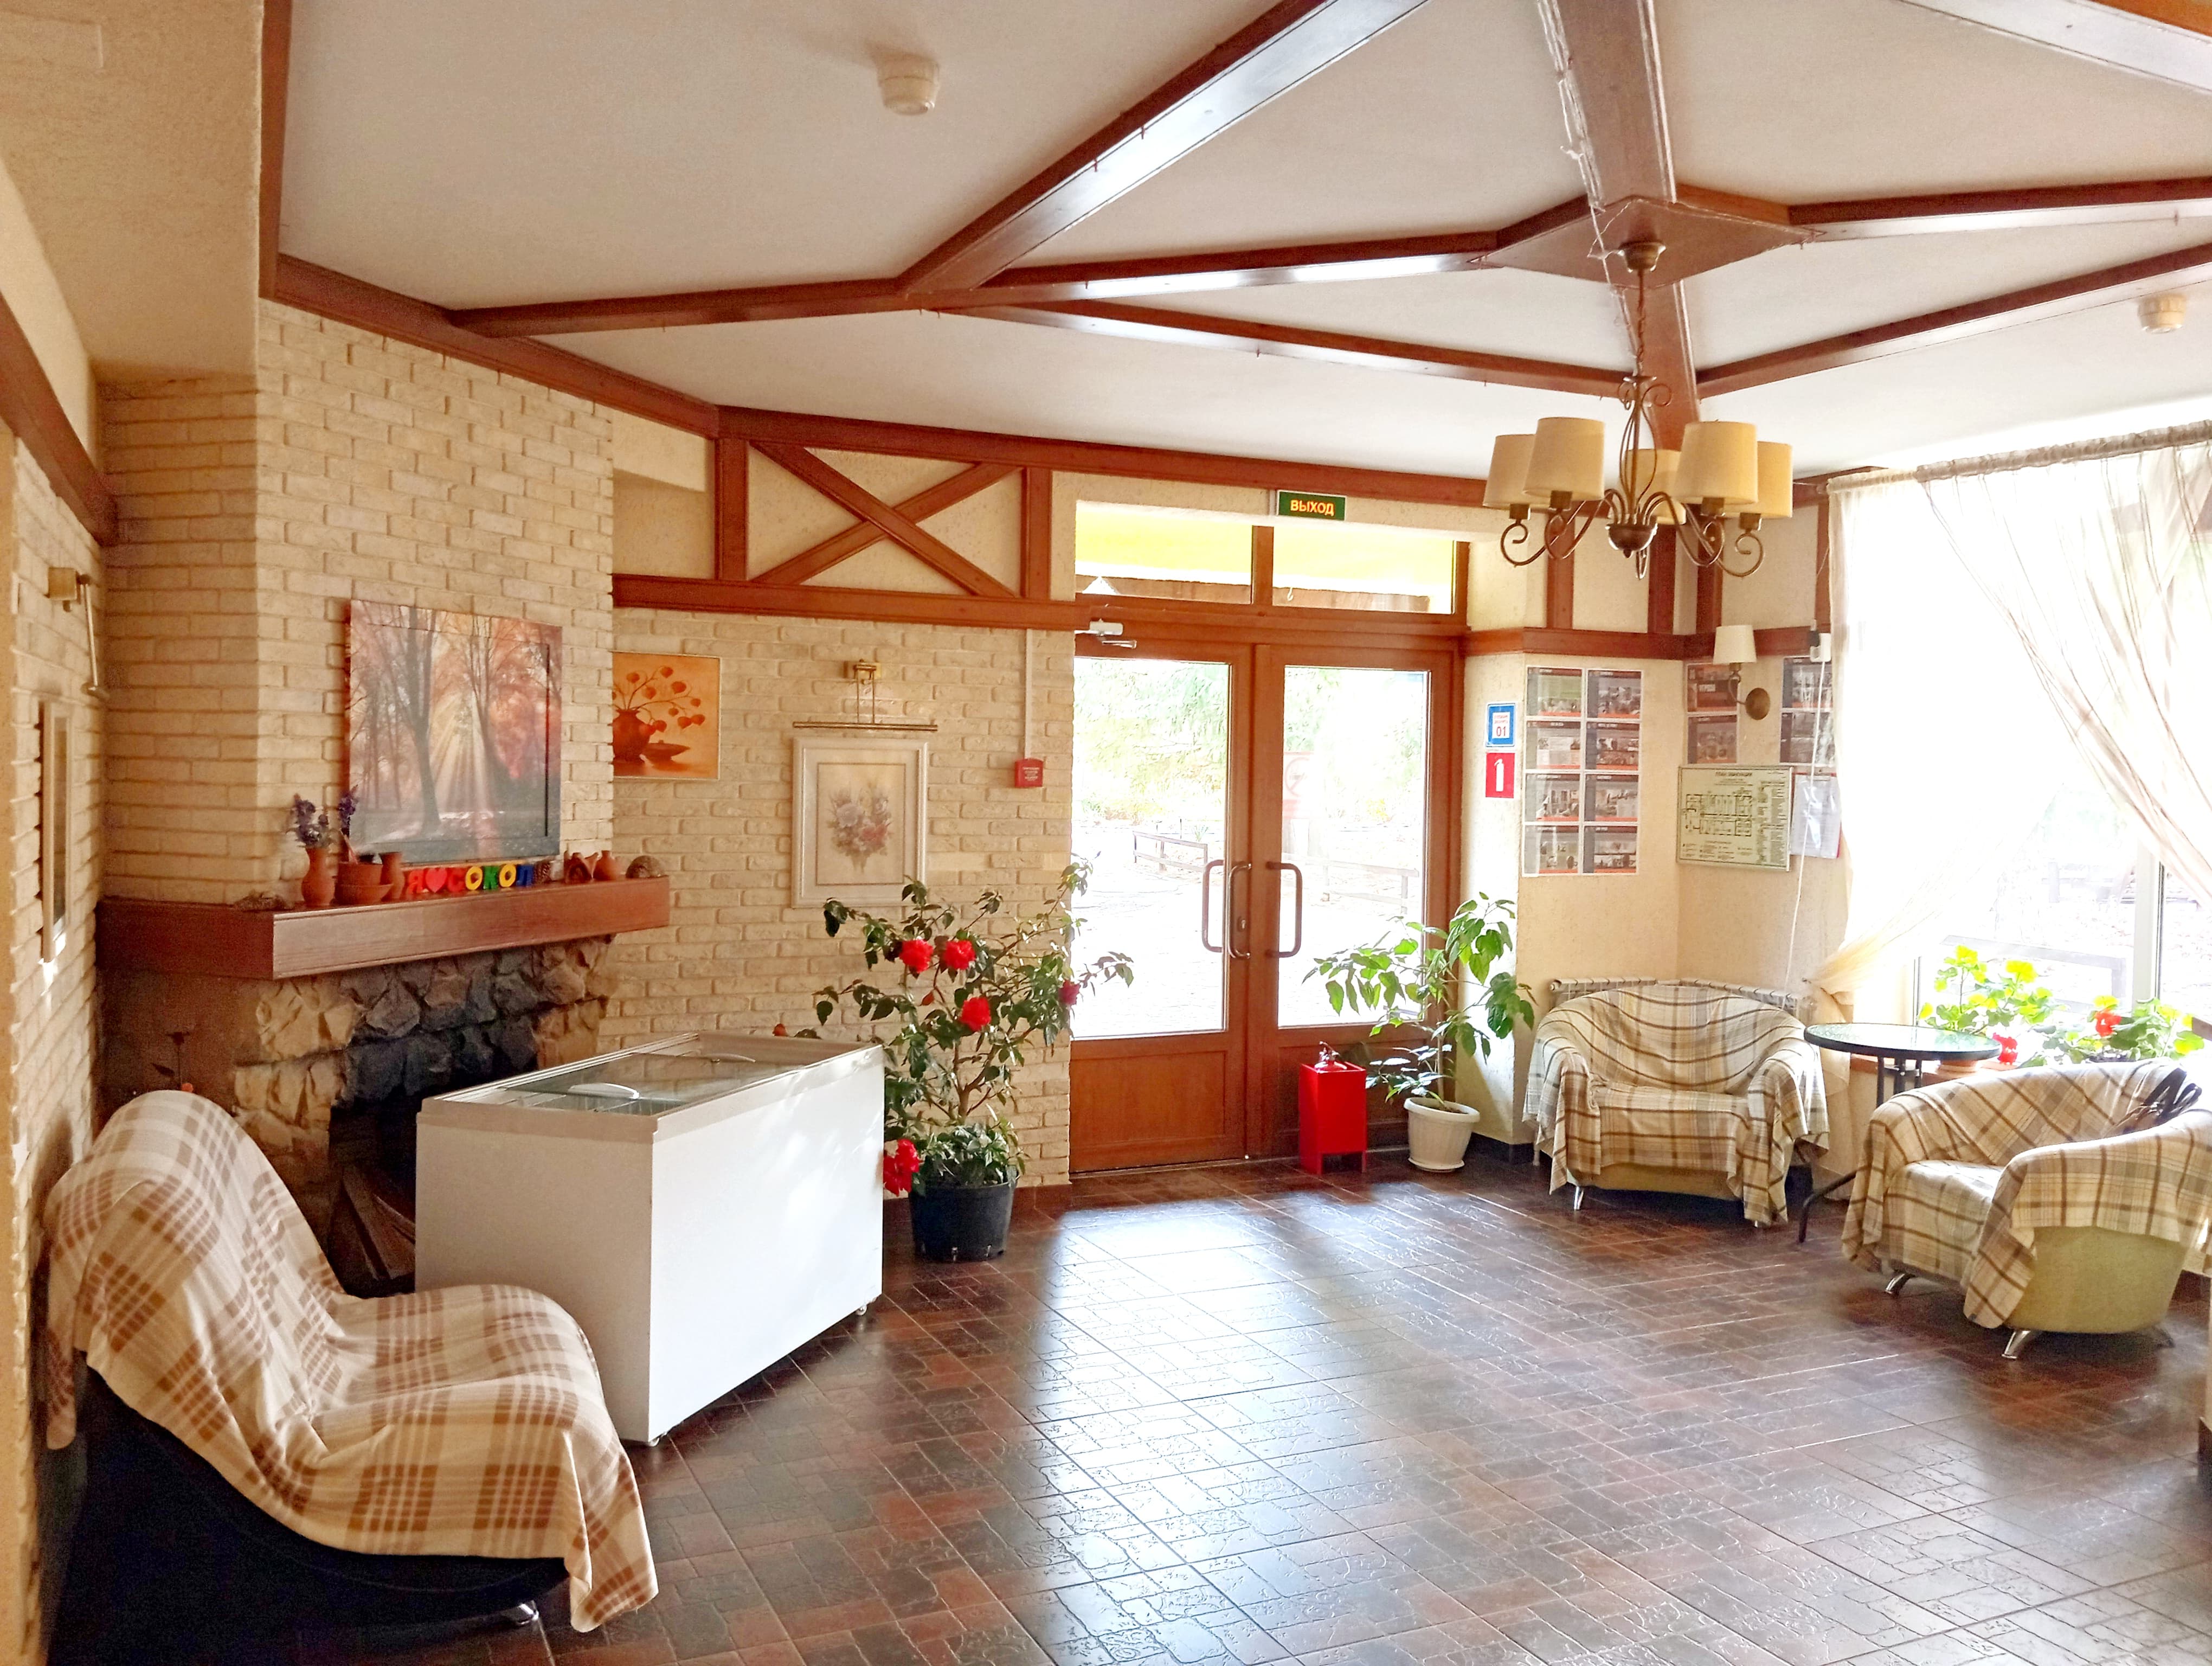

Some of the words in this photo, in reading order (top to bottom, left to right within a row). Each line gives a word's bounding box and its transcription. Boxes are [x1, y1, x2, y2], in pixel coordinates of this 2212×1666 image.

[1290, 499, 1334, 516] ВЫХОД
[1496, 726, 1506, 736] 01
[408, 869, 424, 894] Я
[447, 863, 534, 892] СОКОЛ
